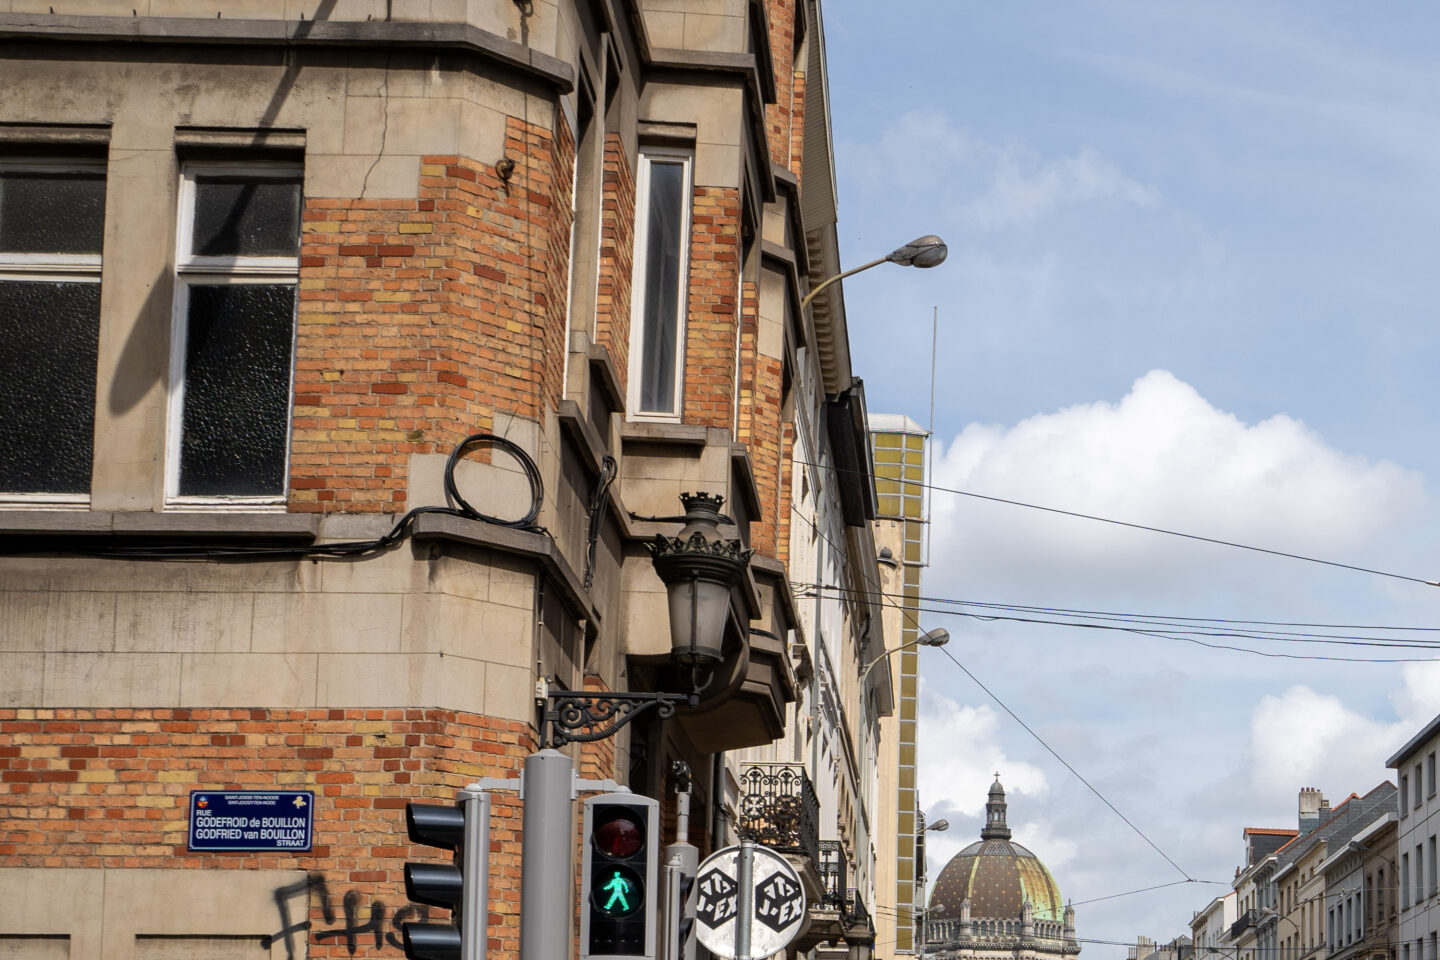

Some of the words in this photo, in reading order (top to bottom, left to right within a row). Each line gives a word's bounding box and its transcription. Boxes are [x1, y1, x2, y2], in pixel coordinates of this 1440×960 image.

[196, 817, 248, 828] GODEFROID
[249, 817, 261, 828] de
[262, 817, 306, 828] BOUILLON
[195, 829, 242, 839] GODFRIED
[243, 831, 259, 839] van
[260, 829, 305, 839] BOUILLON
